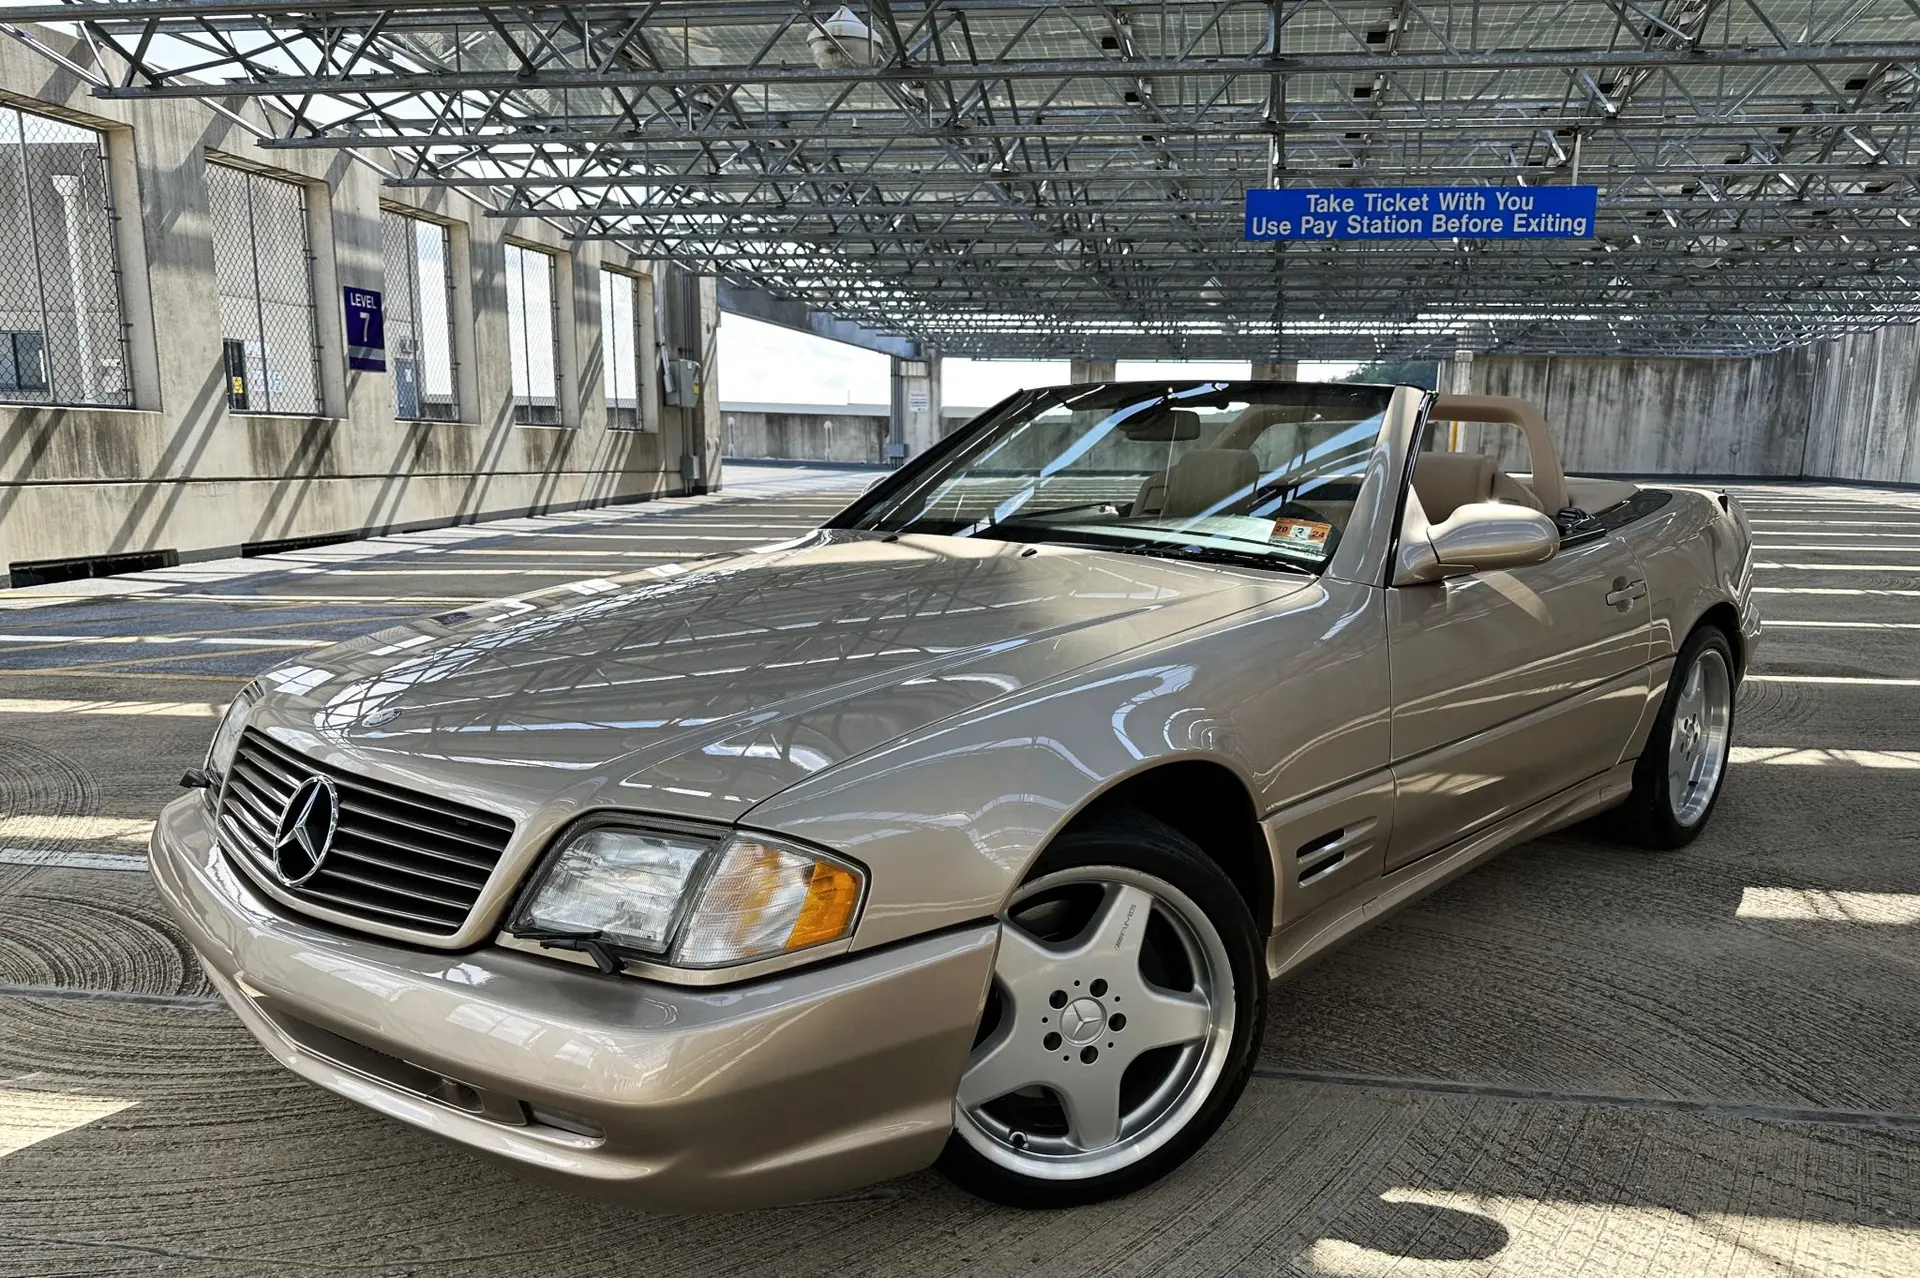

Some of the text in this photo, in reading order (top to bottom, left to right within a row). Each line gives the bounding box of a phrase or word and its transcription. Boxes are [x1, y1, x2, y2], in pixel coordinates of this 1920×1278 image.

[1306, 191, 1534, 213] Take Ticket With You
[1252, 213, 1587, 238] Use Pay Station Before Exiting
[350, 292, 377, 309] LEVEL
[359, 311, 370, 342] 7
[1275, 525, 1288, 533] 20
[1311, 530, 1325, 538] 24
